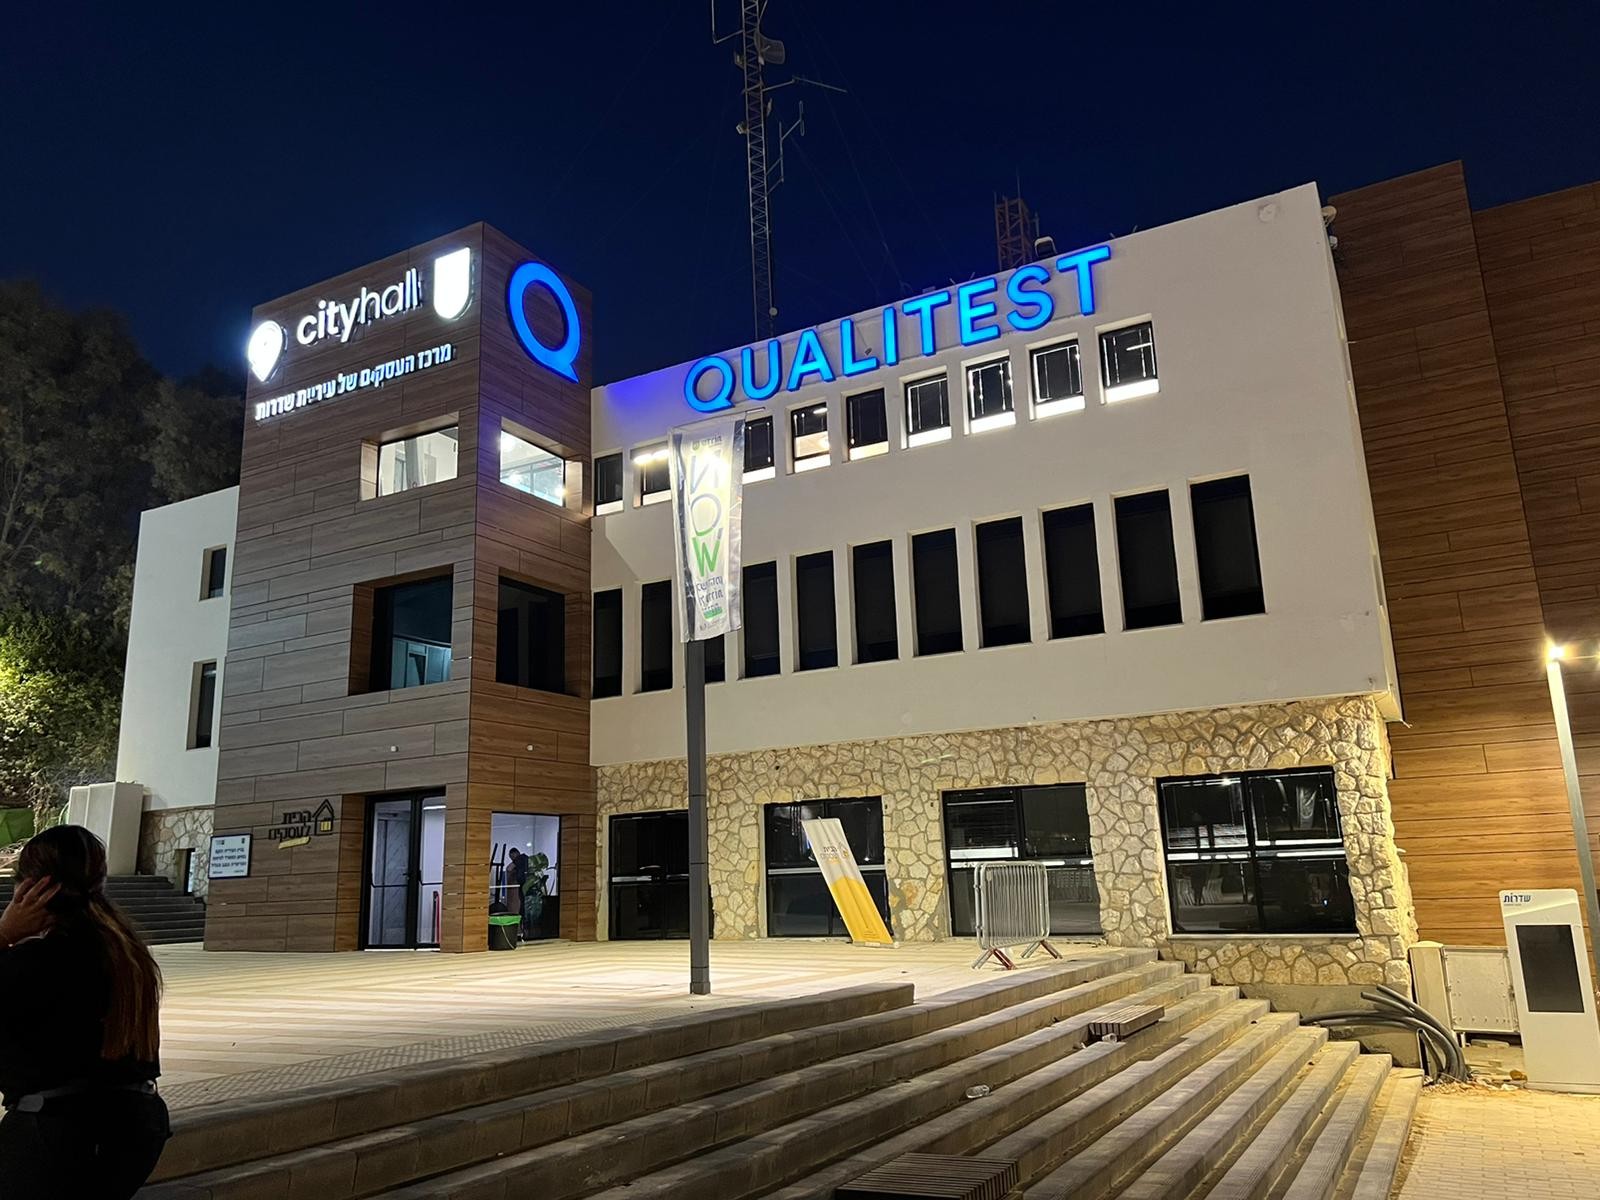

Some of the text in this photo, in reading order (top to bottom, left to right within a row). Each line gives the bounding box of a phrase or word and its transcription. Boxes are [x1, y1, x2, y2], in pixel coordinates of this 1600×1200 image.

[297, 267, 419, 343] cityhall
[683, 245, 1110, 413] QUALITEST
[255, 343, 452, 421] מרכז העסקים של עיריית שדרות
[268, 825, 311, 843] לעסקים
